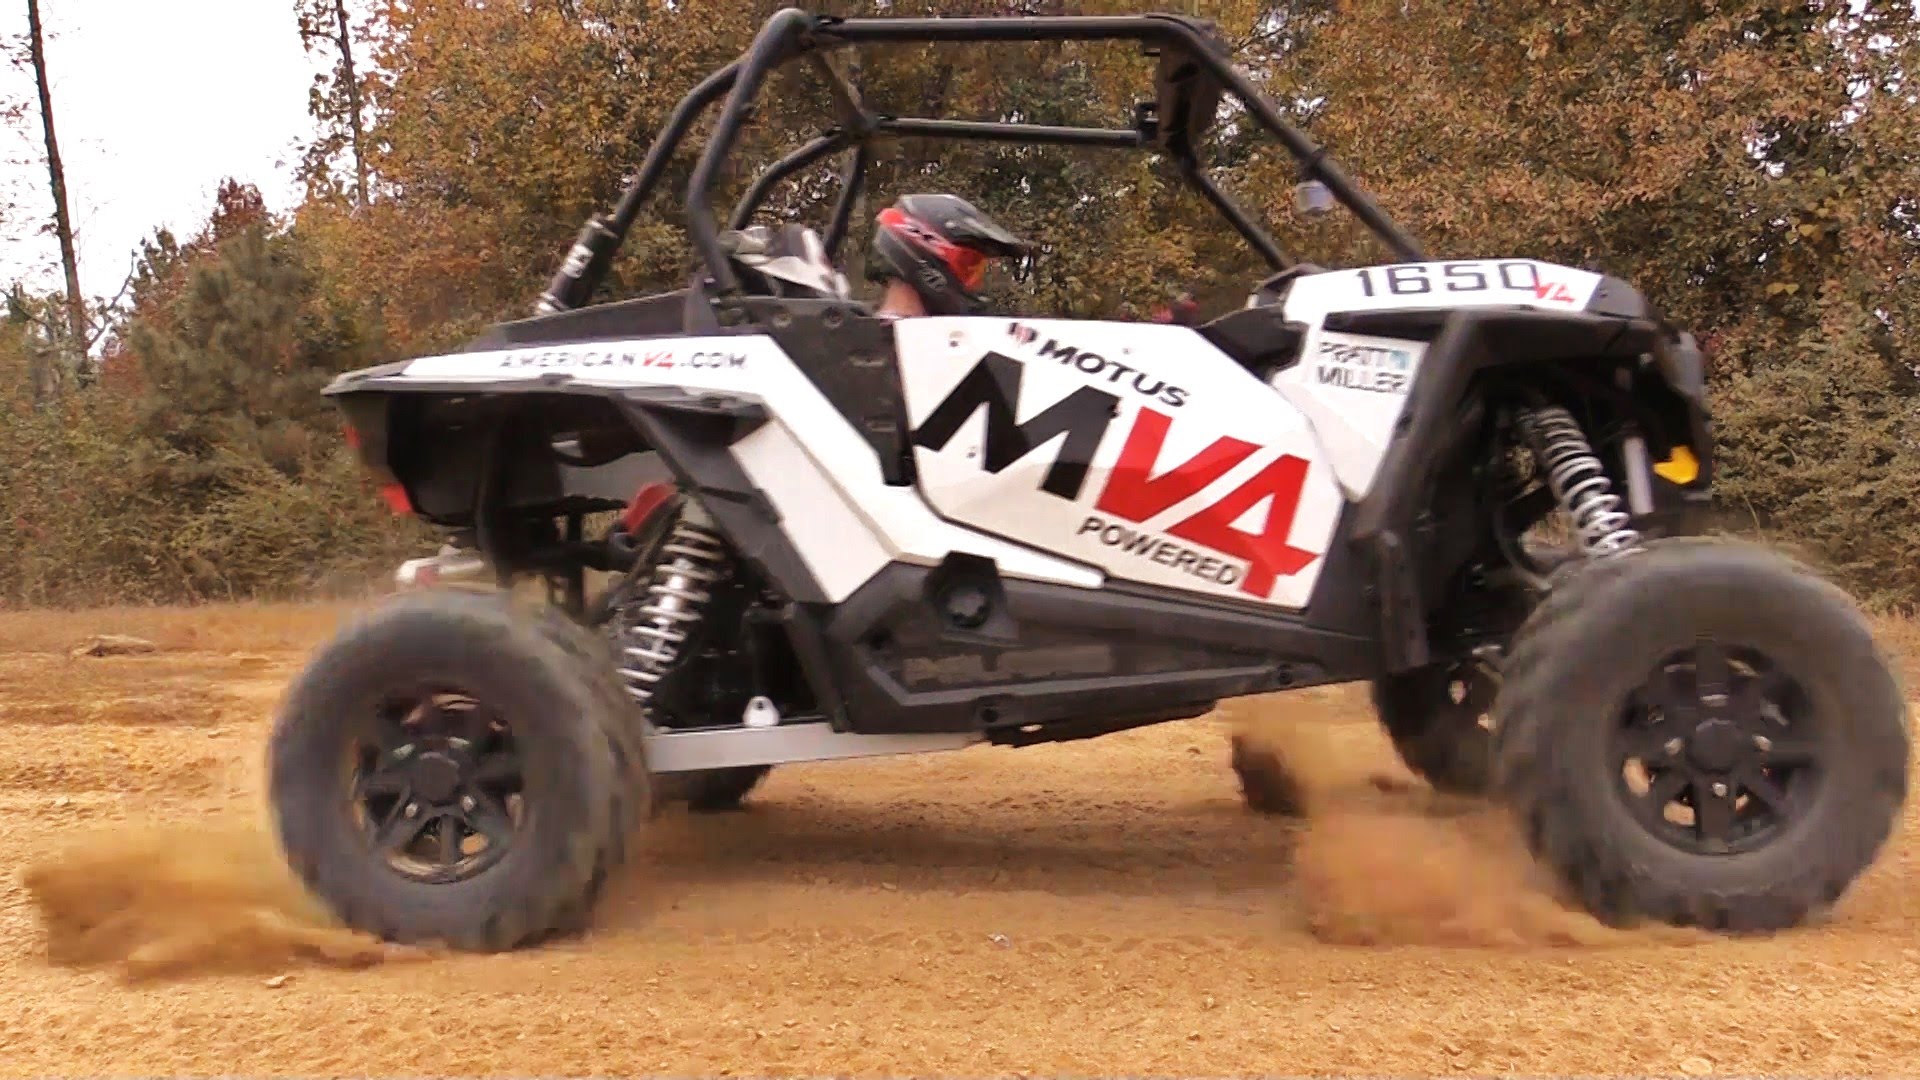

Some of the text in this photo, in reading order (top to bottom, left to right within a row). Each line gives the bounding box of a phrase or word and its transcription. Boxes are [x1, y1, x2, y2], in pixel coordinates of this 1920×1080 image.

[1356, 262, 1541, 297] 1650
[1320, 341, 1391, 367] PRATT
[1037, 338, 1191, 408] MOTUS
[1317, 364, 1407, 396] MILLER
[1075, 516, 1243, 586] POWERED
